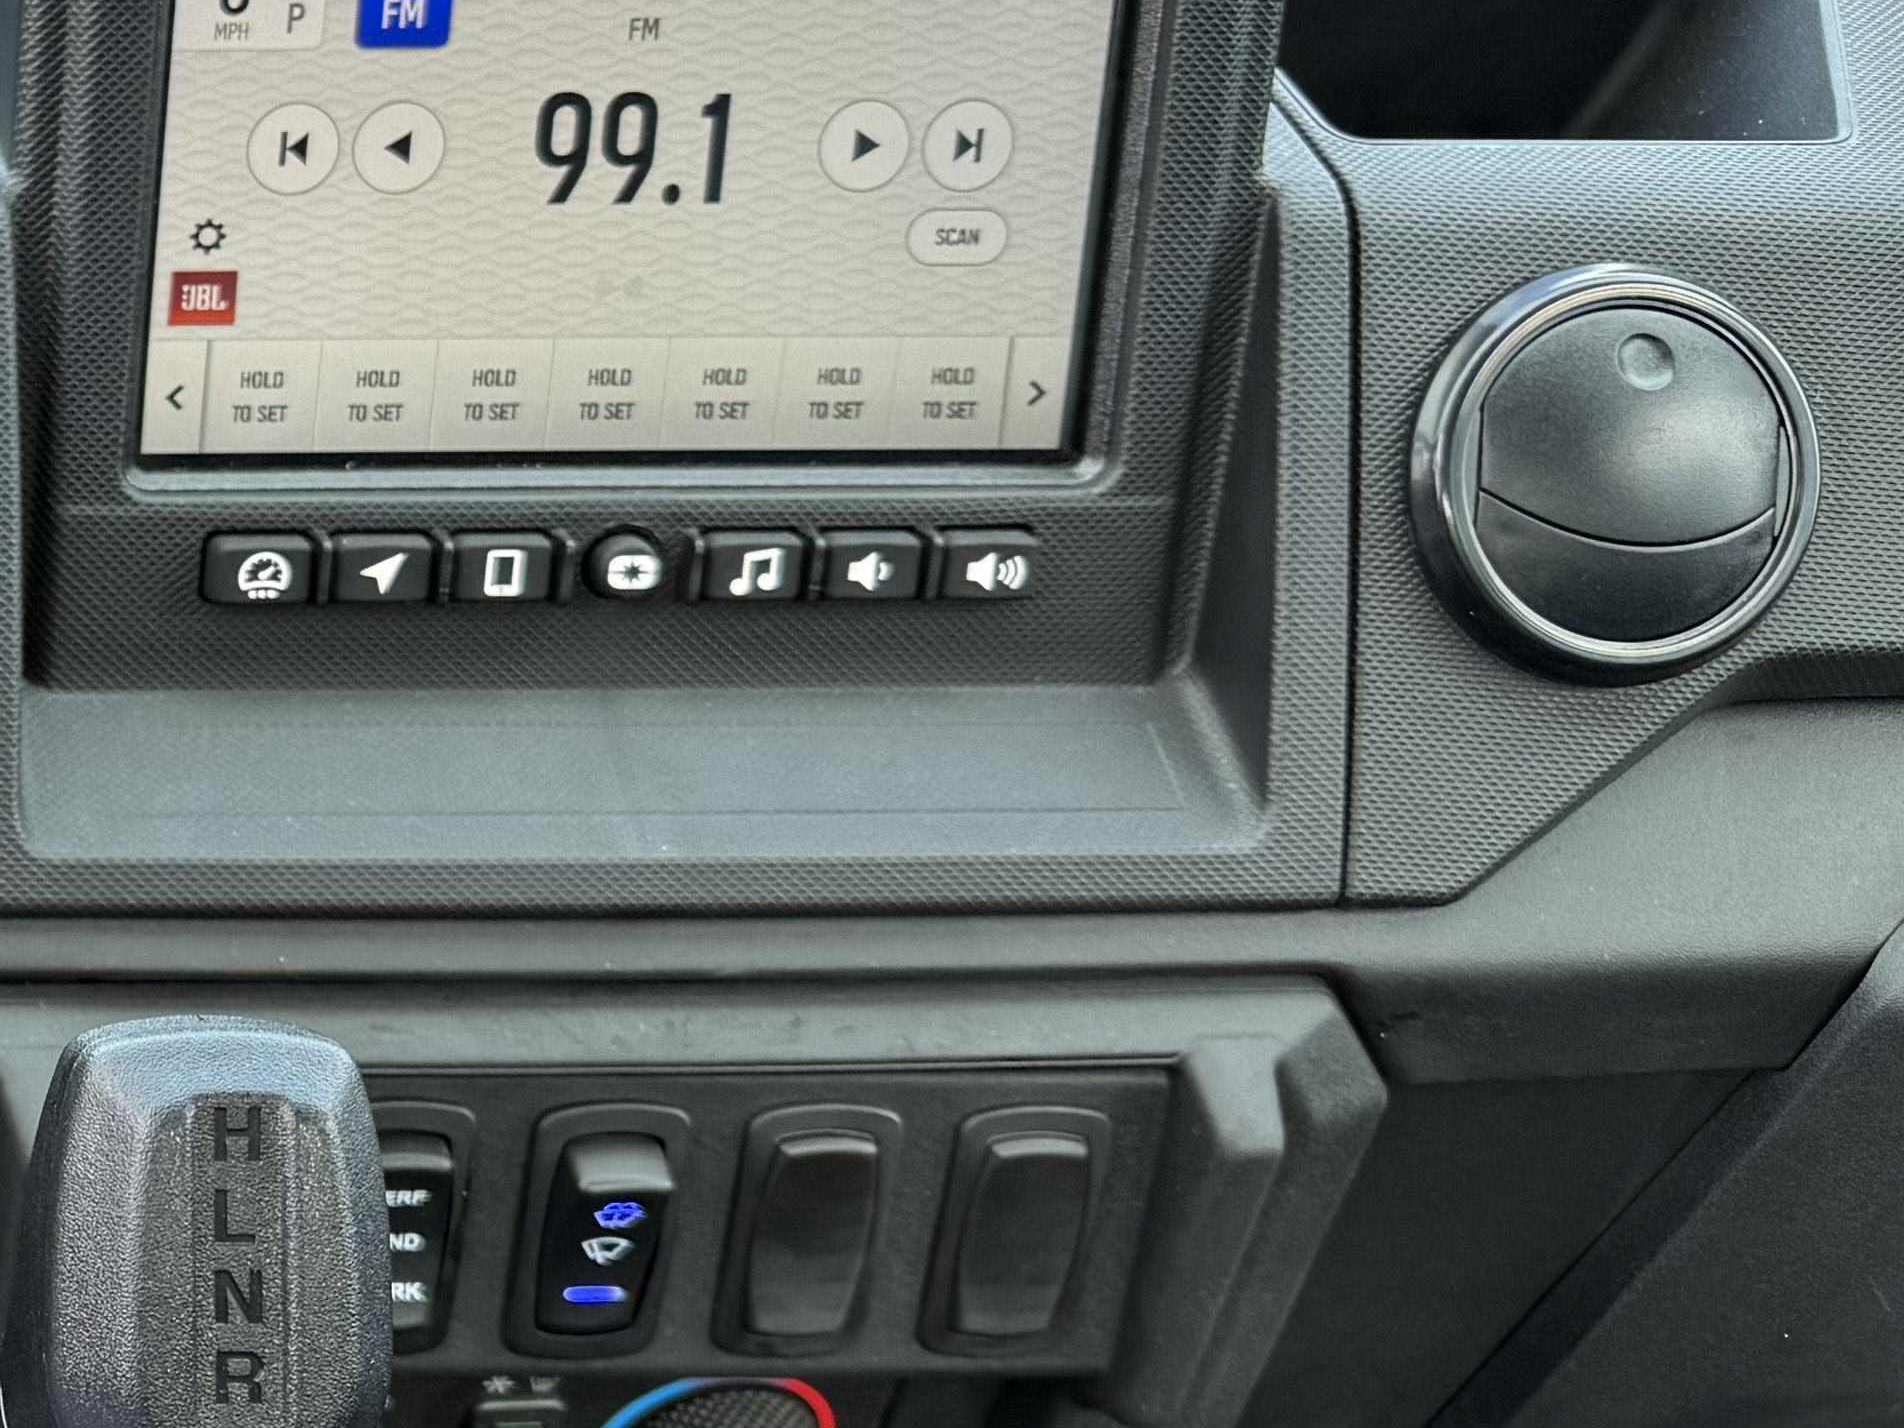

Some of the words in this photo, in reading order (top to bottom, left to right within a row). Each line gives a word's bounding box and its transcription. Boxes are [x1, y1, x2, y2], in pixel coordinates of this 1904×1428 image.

[286, 2, 306, 35] P
[213, 22, 250, 42] MPH
[628, 17, 661, 42] FM
[534, 91, 733, 206] 99.1
[934, 228, 980, 247] SCAN
[180, 282, 229, 312] JBL
[240, 371, 284, 389] HOLD
[355, 370, 400, 388] HOLD
[471, 369, 516, 387] HOLD
[587, 368, 632, 386] HOLD
[702, 368, 747, 386] HOLD
[816, 367, 861, 386] HOLD
[930, 367, 975, 385] HOLD
[232, 404, 253, 423] TO
[257, 404, 288, 423] SET
[348, 404, 368, 422] TO
[373, 404, 403, 422] SET
[463, 403, 484, 421] TO
[488, 403, 519, 421] SET
[579, 402, 599, 420] TO
[604, 402, 635, 420] SET
[694, 402, 714, 420] TO
[719, 402, 750, 420] SET
[808, 401, 828, 420] TO
[833, 401, 864, 420] SET
[922, 401, 942, 420] TO
[947, 401, 978, 420] SET
[213, 1106, 262, 1161] H
[385, 1189, 432, 1207] ERF
[214, 1188, 257, 1243] L
[215, 1269, 264, 1325] N
[216, 1351, 265, 1404] R
